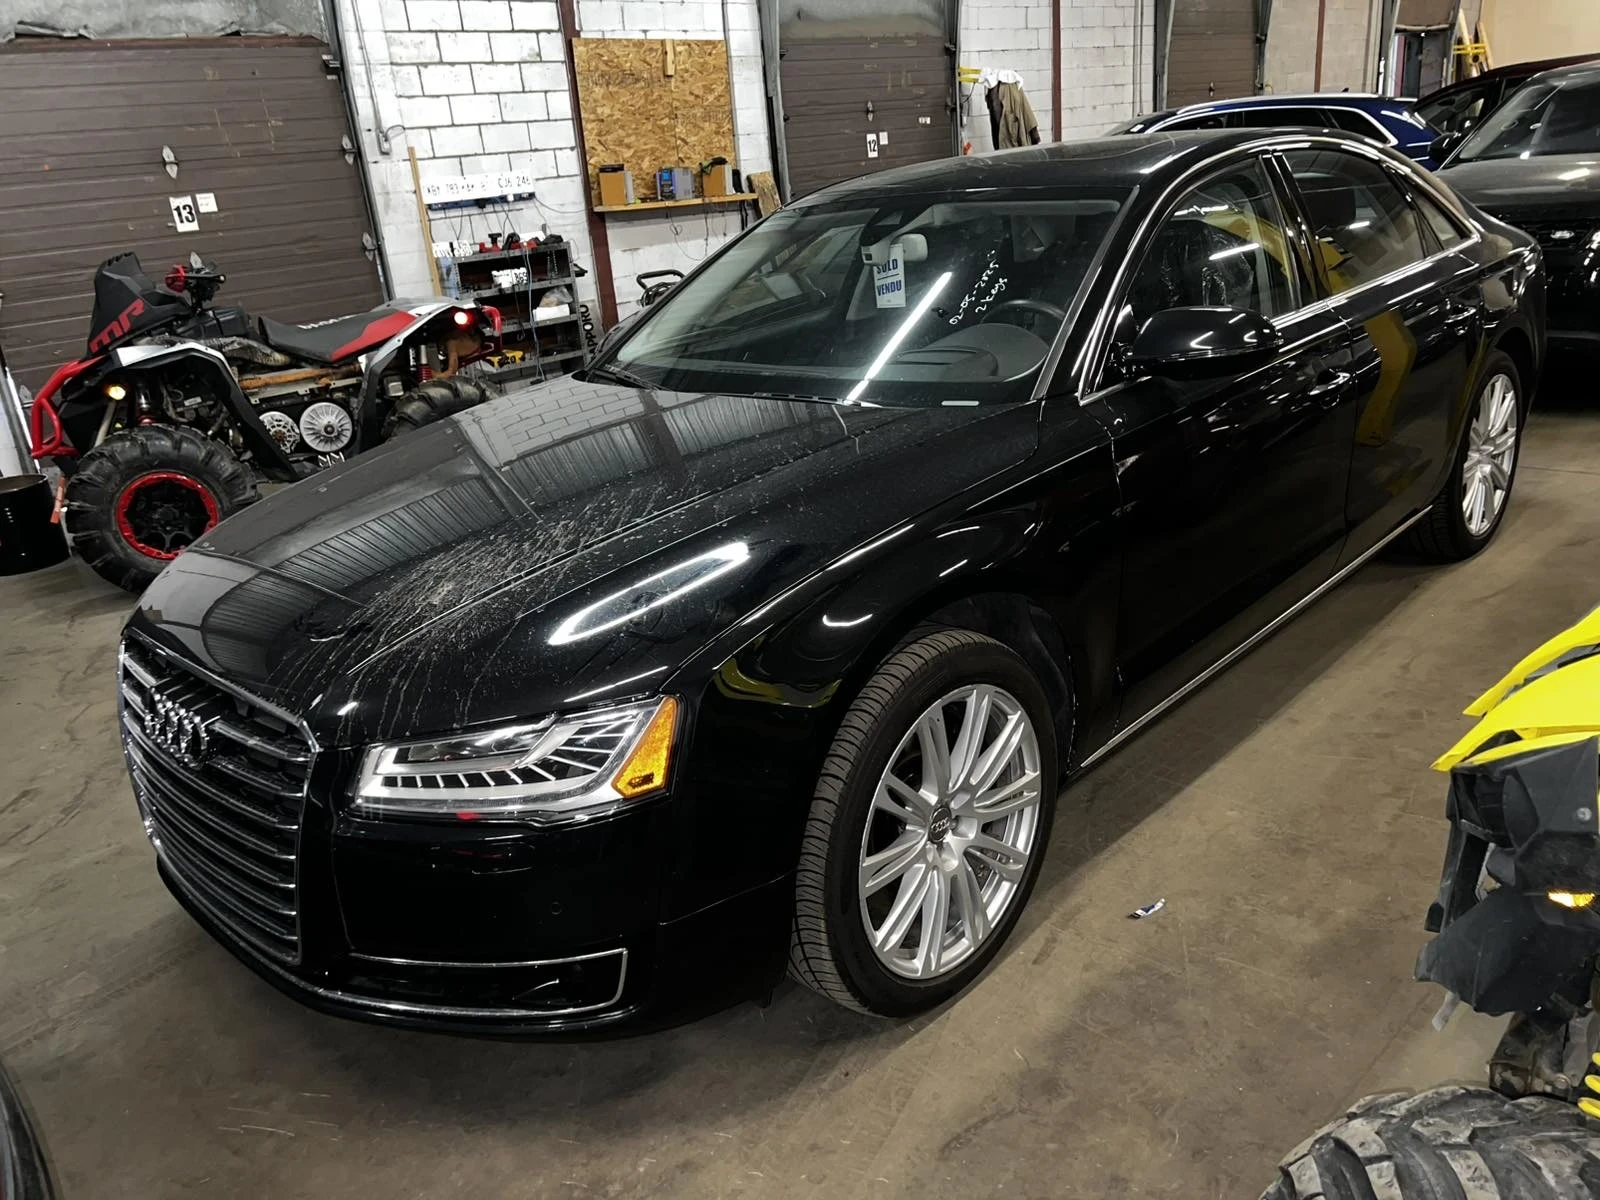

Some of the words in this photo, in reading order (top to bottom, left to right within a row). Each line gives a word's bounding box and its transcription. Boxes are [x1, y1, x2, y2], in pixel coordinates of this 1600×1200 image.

[866, 139, 878, 153] 12
[173, 204, 196, 224] 13
[876, 259, 898, 274] SOLD
[877, 280, 902, 296] VENDU
